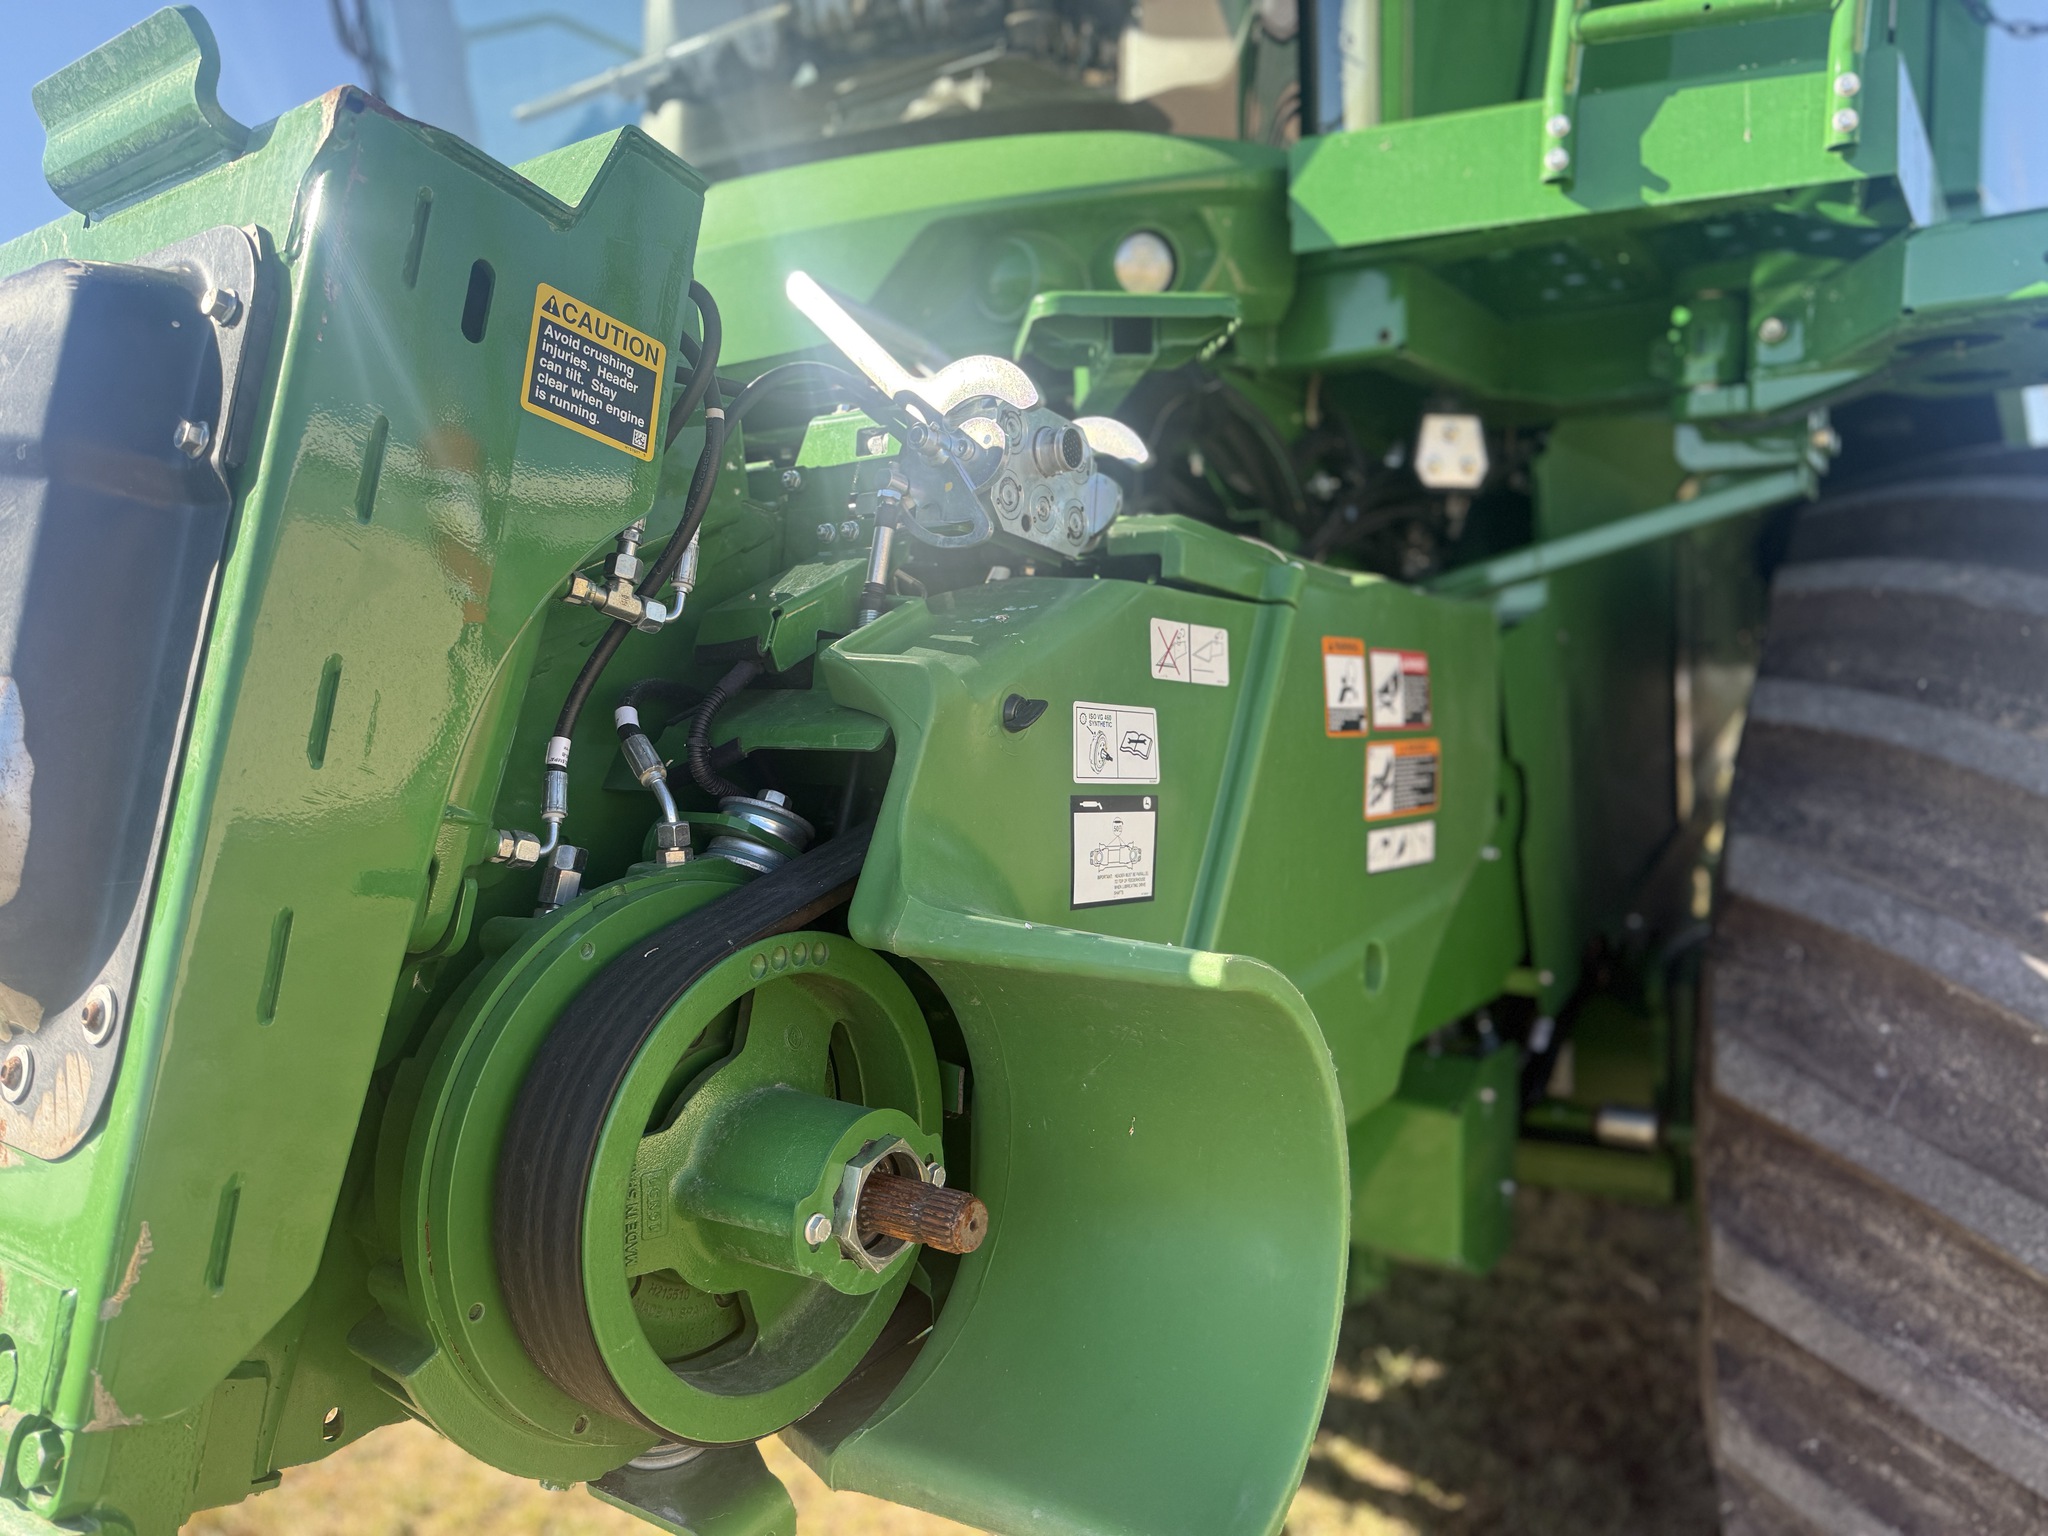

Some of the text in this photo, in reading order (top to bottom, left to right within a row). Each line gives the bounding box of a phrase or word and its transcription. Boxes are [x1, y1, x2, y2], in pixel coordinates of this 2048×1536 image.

[544, 324, 635, 379] Avoid crushing
[562, 302, 660, 366] CAUTION
[539, 356, 618, 402] can tilt. Stay
[541, 339, 639, 394] injuries. Header
[535, 385, 600, 425] is running.
[537, 372, 645, 428] clear when engine
[1088, 720, 1112, 728] SYNTHETIC
[625, 1202, 638, 1220] IN
[625, 1221, 638, 1267] MADE
